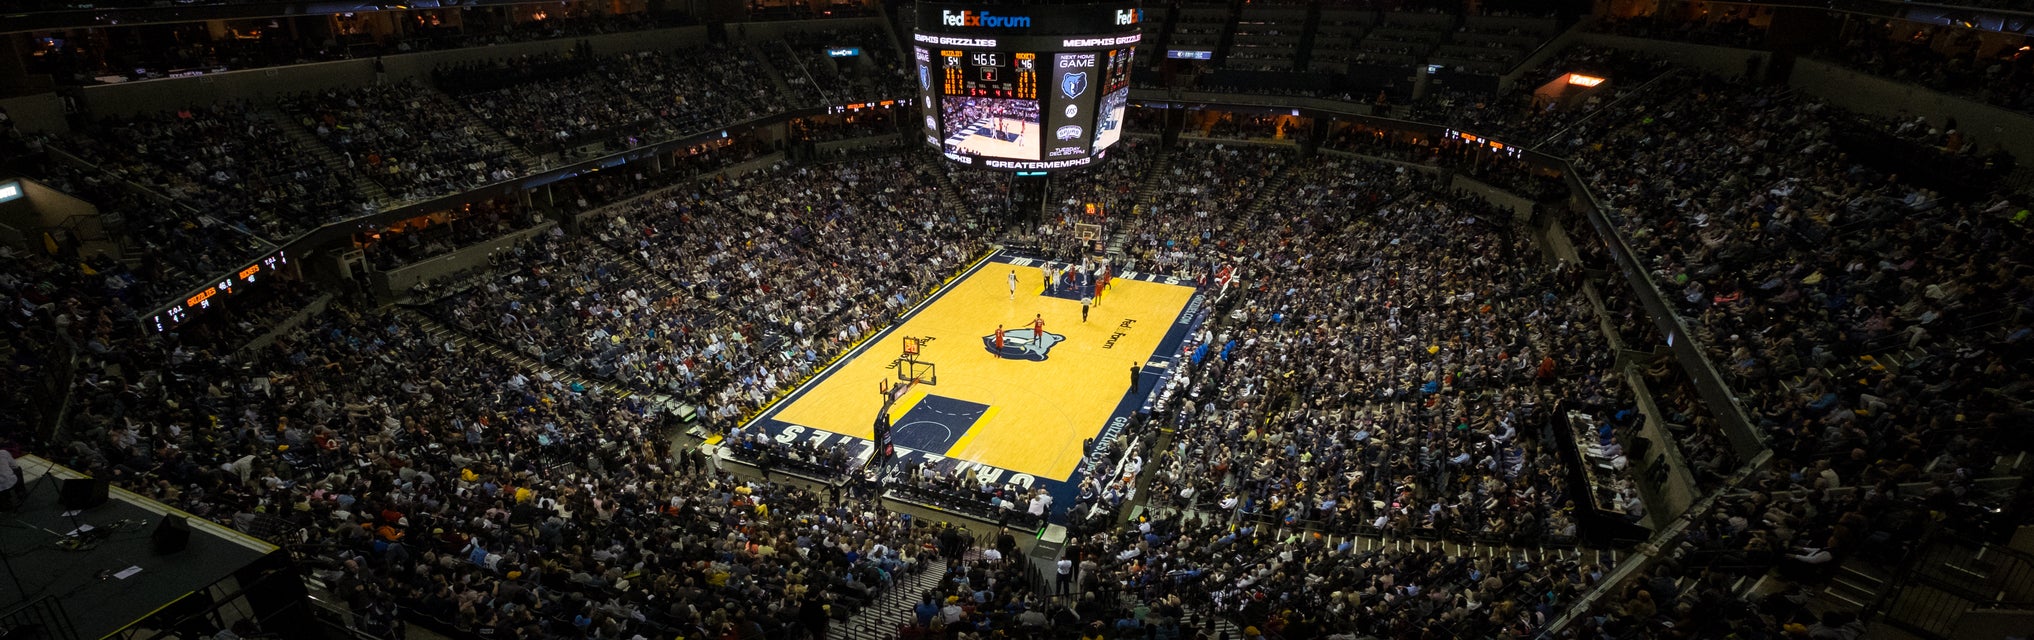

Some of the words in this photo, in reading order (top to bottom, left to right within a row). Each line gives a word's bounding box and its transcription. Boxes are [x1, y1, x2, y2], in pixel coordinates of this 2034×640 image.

[943, 10, 1030, 28] FedExForum
[940, 37, 997, 47] GRIZZLIES
[1063, 38, 1115, 48] MEMPHIS
[947, 56, 959, 66] 54
[973, 53, 997, 66] 46.6
[1021, 59, 1033, 69] 46
[1059, 60, 1096, 69] GAME
[986, 72, 992, 80] 2
[985, 157, 1091, 170] #GREATERMEMPHIS
[239, 264, 260, 280] ROCKETS
[186, 286, 217, 308] GRIZZLIES
